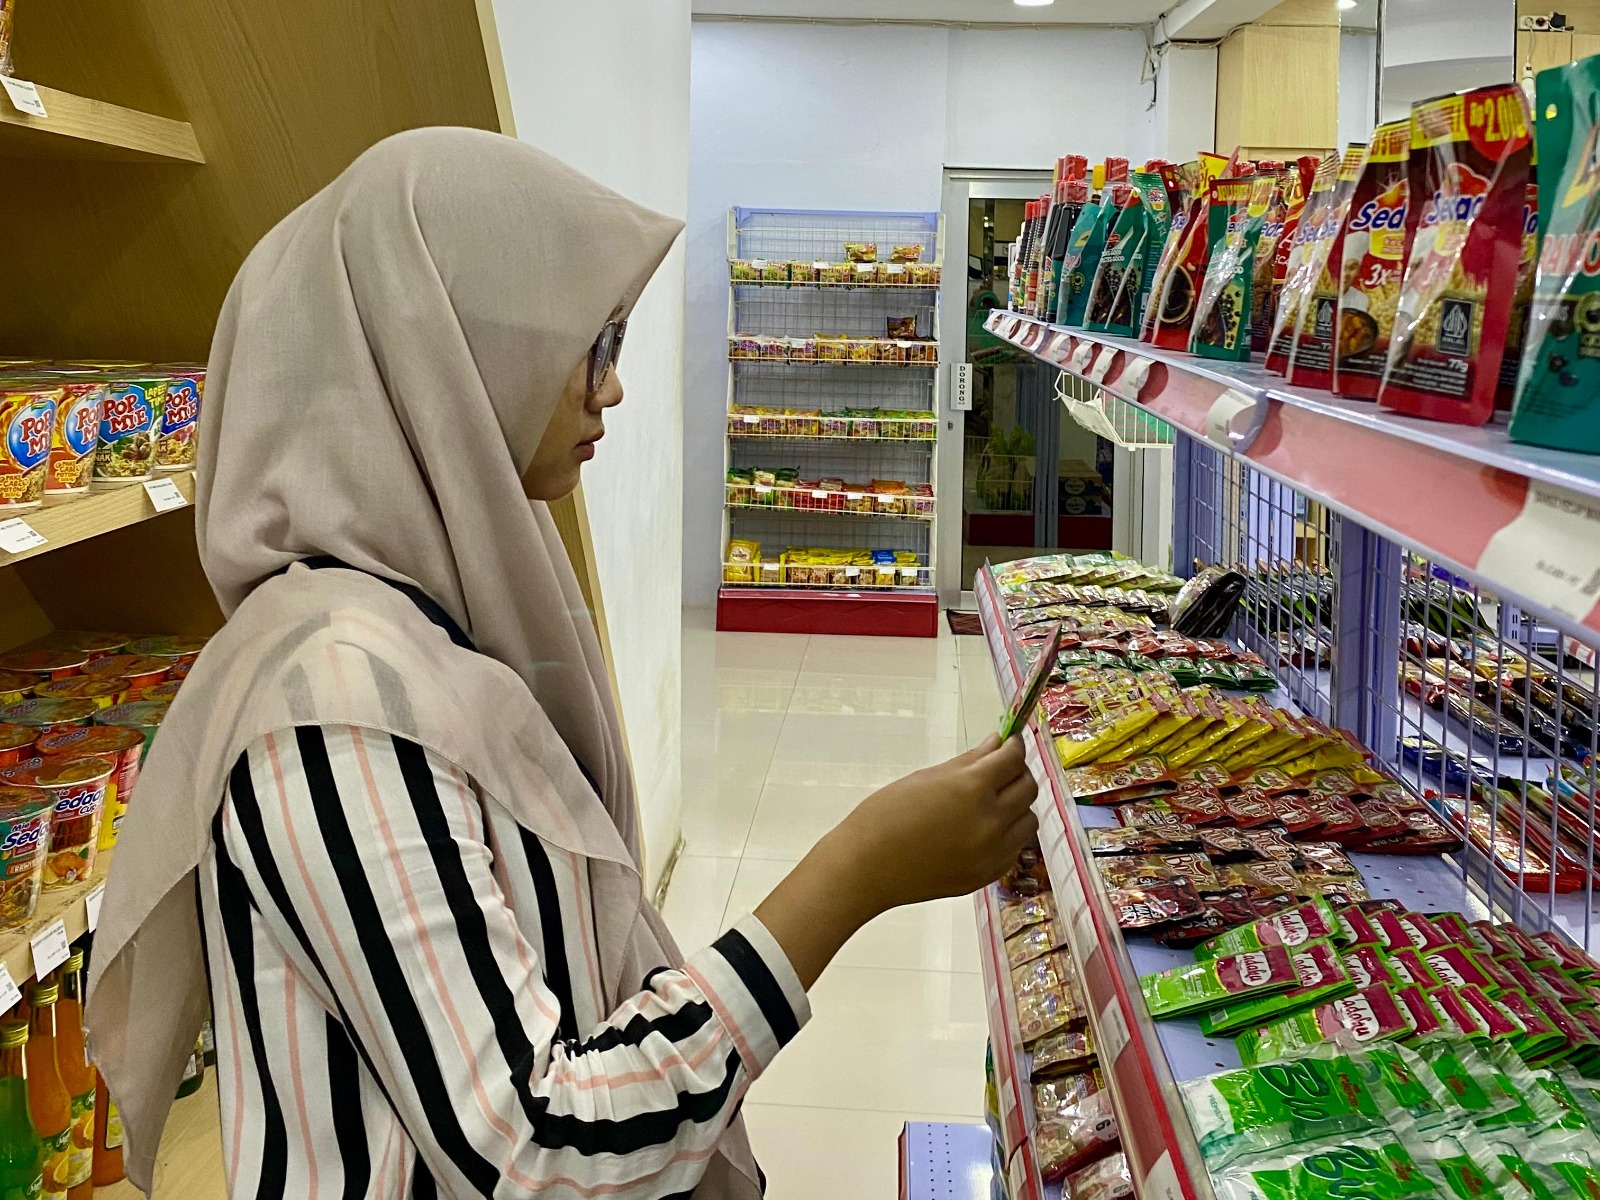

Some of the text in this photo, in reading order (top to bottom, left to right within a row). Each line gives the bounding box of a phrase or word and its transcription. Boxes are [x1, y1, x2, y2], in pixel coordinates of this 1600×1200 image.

[104, 394, 138, 419] POP
[110, 408, 148, 434] MIE
[21, 410, 52, 441] POP
[1243, 952, 1267, 982] adaku
[1259, 1057, 1330, 1121] Bio
[1302, 1145, 1381, 1200] Bi
